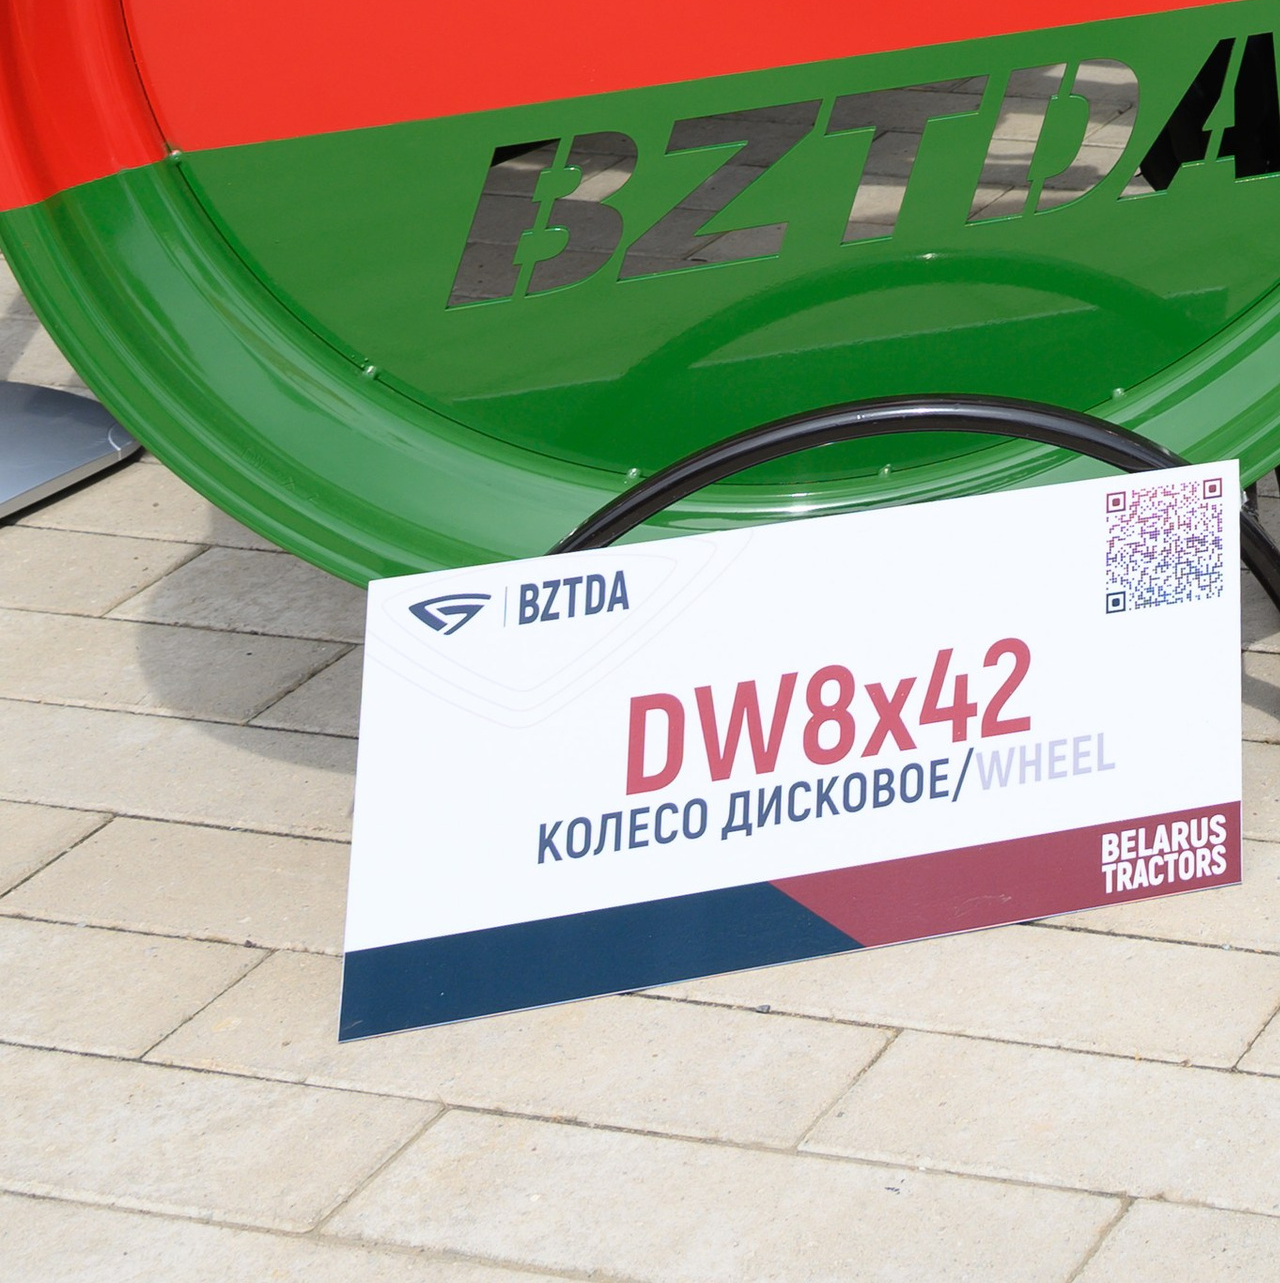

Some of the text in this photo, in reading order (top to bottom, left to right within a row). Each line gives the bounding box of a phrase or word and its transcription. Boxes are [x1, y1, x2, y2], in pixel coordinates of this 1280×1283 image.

[517, 569, 630, 626] BZTDA
[625, 637, 1032, 797] DW8x42
[537, 795, 708, 864] КОЛЕСО
[1101, 814, 1227, 864] BELARUS
[1101, 844, 1227, 894] TRACTORS
